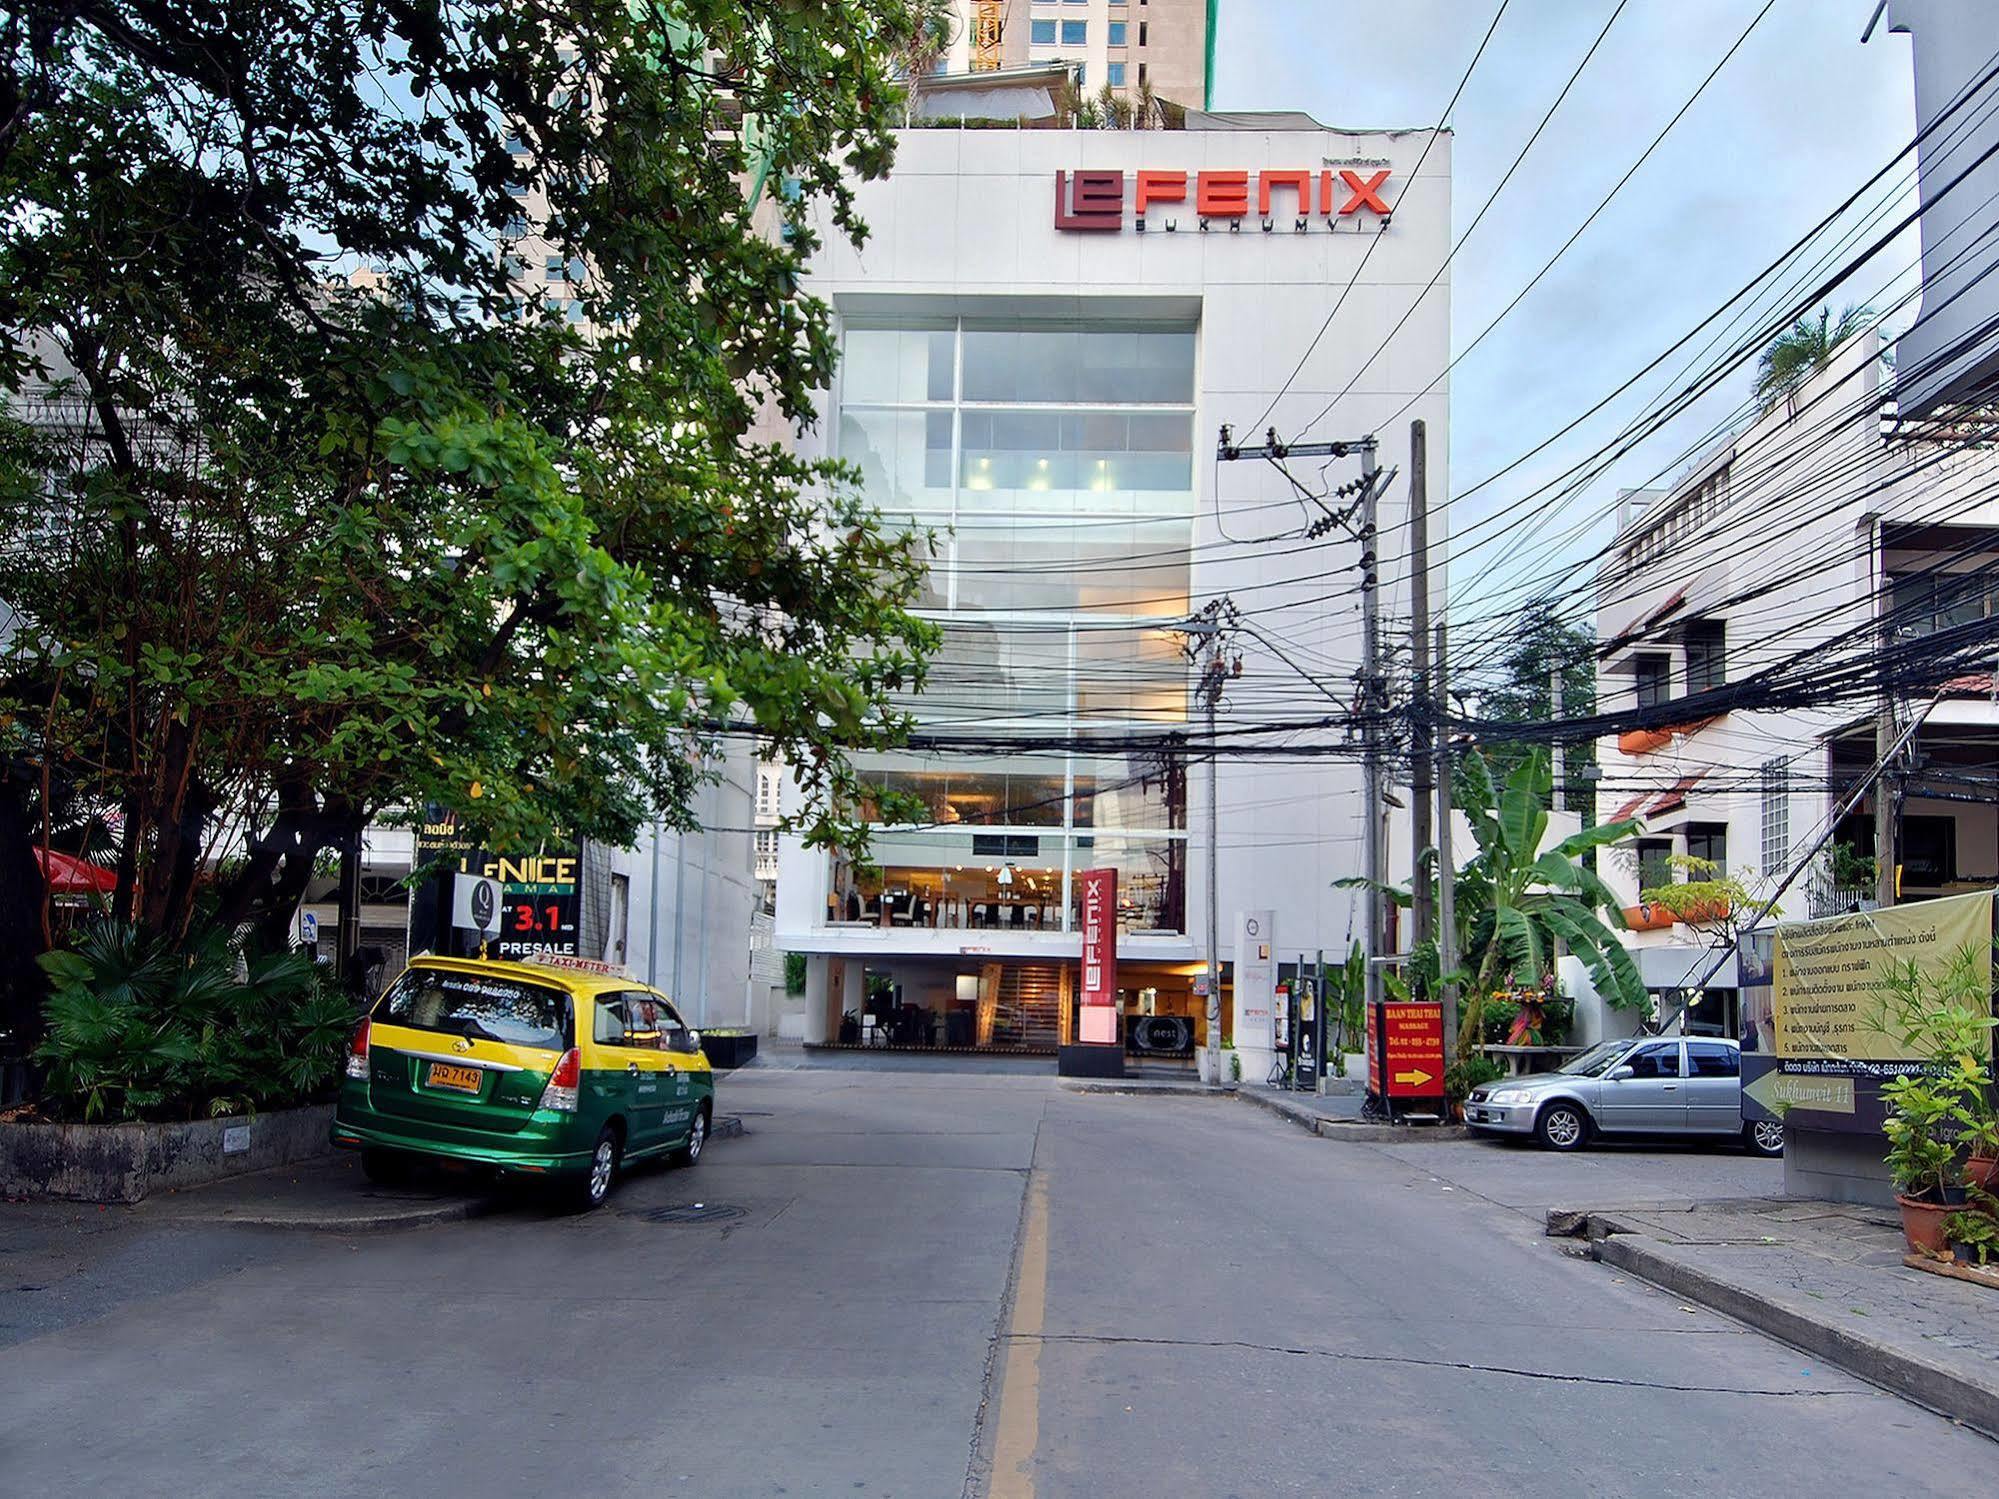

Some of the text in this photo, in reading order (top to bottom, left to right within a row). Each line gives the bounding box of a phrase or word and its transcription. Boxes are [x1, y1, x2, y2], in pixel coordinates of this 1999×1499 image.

[1136, 169, 1392, 215] FENIX
[502, 905, 513, 913] AT
[514, 904, 560, 931] 3.1
[499, 942, 575, 955] PRESALE
[549, 956, 610, 973] TAXI-METER
[453, 1069, 478, 1083] 7143
